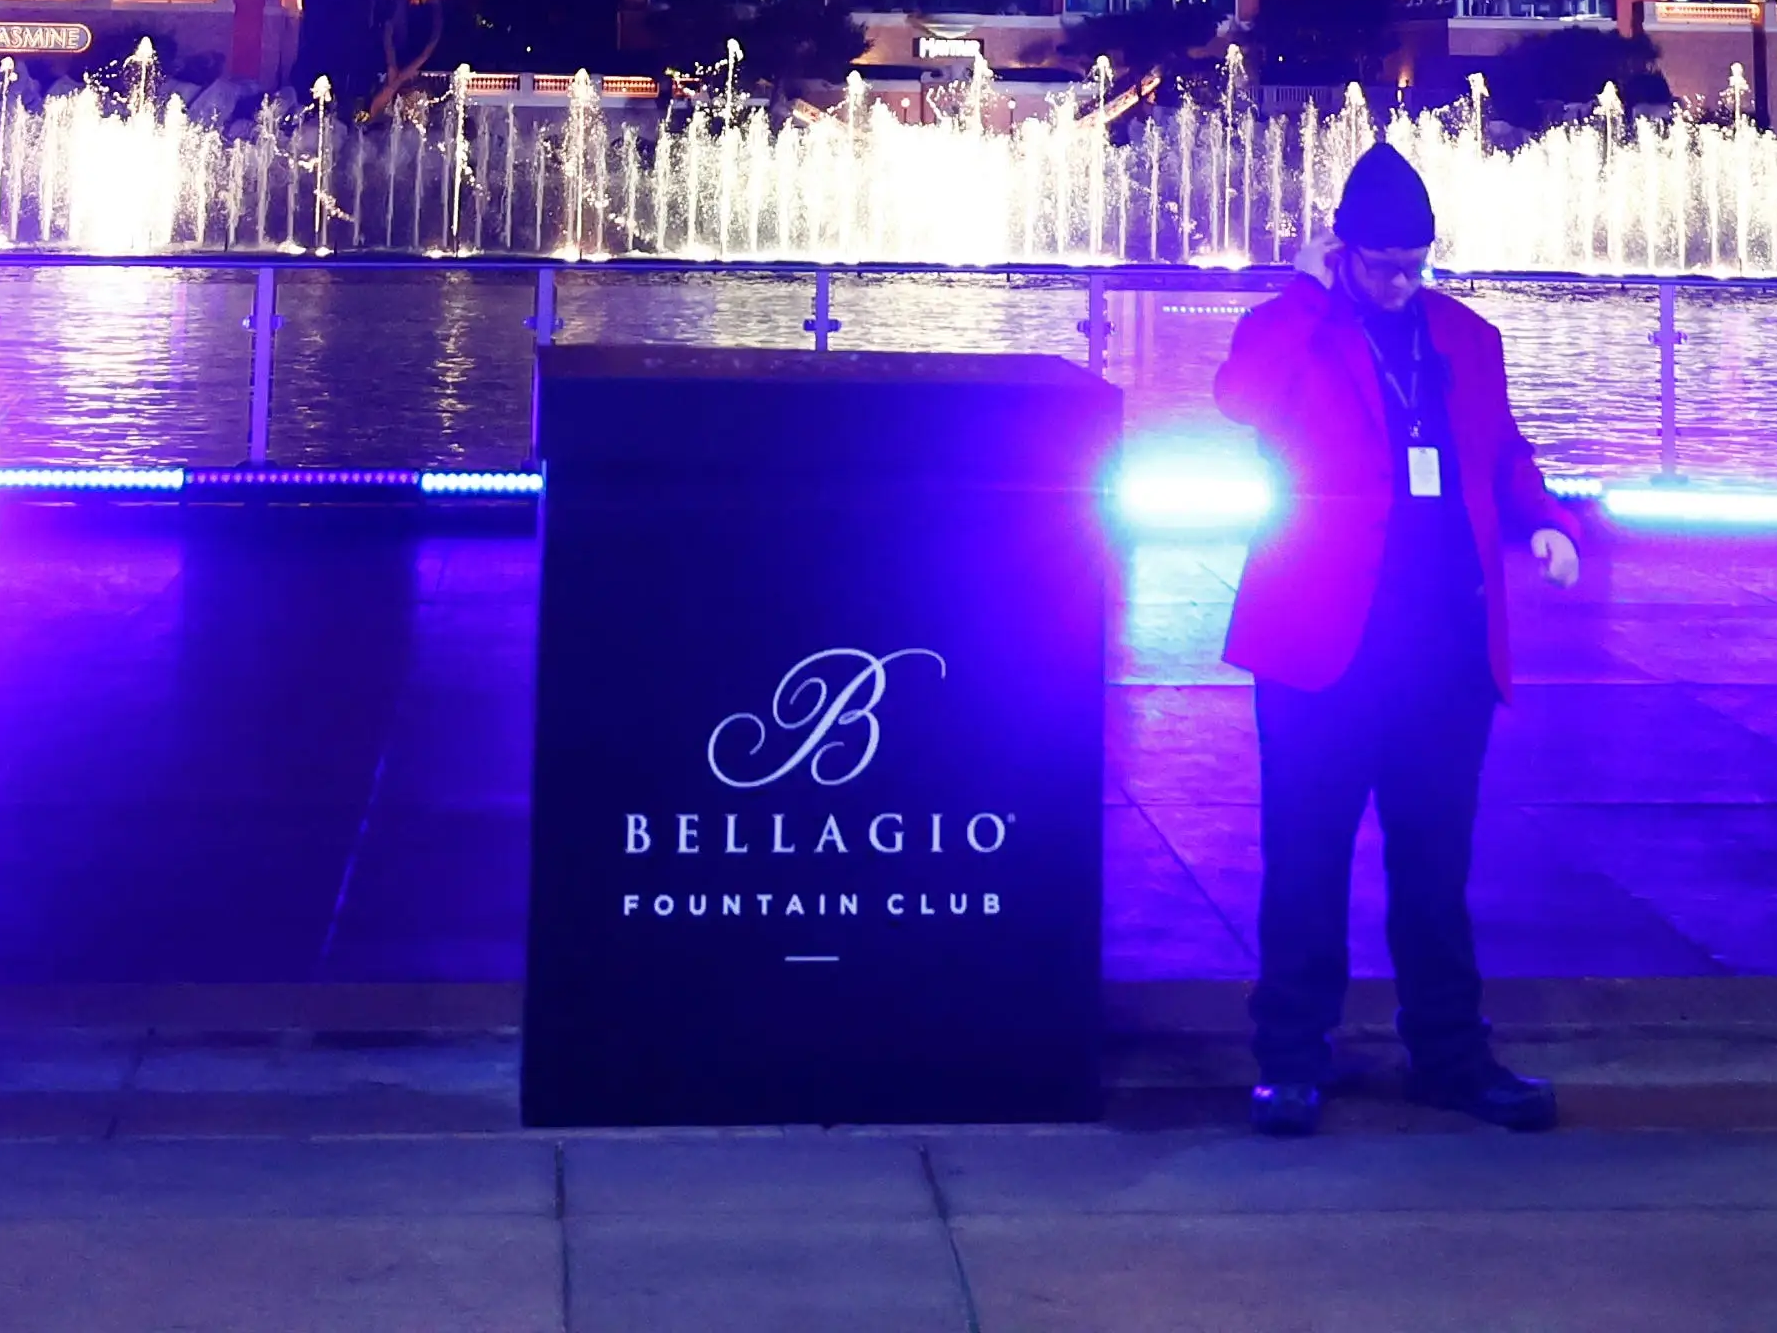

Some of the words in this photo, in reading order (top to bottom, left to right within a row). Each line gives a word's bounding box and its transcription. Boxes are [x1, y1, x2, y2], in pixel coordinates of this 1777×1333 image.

[708, 647, 947, 788] B
[624, 812, 1007, 854] BELLAGIO
[623, 893, 860, 916] FOUNTAIN
[887, 892, 1002, 915] CLUB
